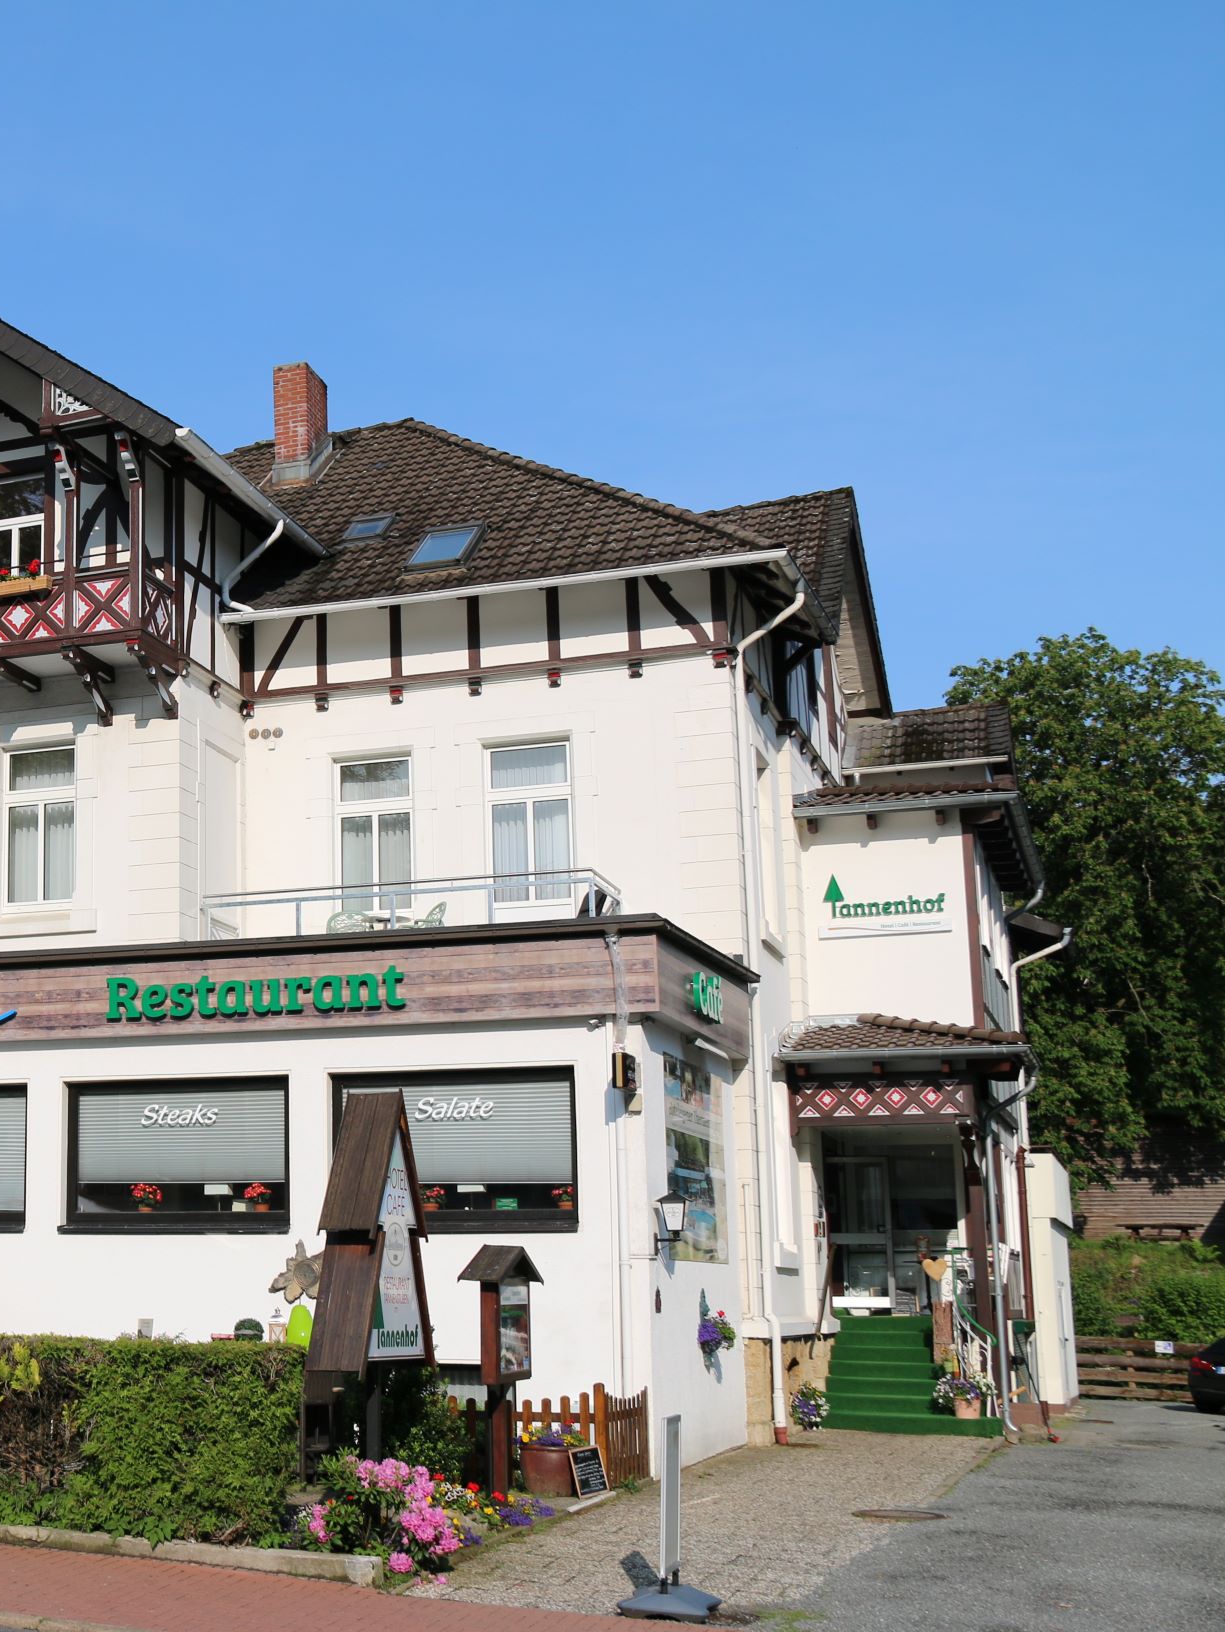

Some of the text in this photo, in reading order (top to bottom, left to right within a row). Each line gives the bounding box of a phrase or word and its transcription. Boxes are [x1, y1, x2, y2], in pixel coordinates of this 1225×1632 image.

[823, 886, 945, 919] Tannenhof
[106, 965, 407, 1023] Restaurant
[693, 971, 723, 1024] Café
[141, 1104, 218, 1127] Steaks
[415, 1097, 494, 1121] Salate
[377, 1323, 419, 1349] Tannenhof
